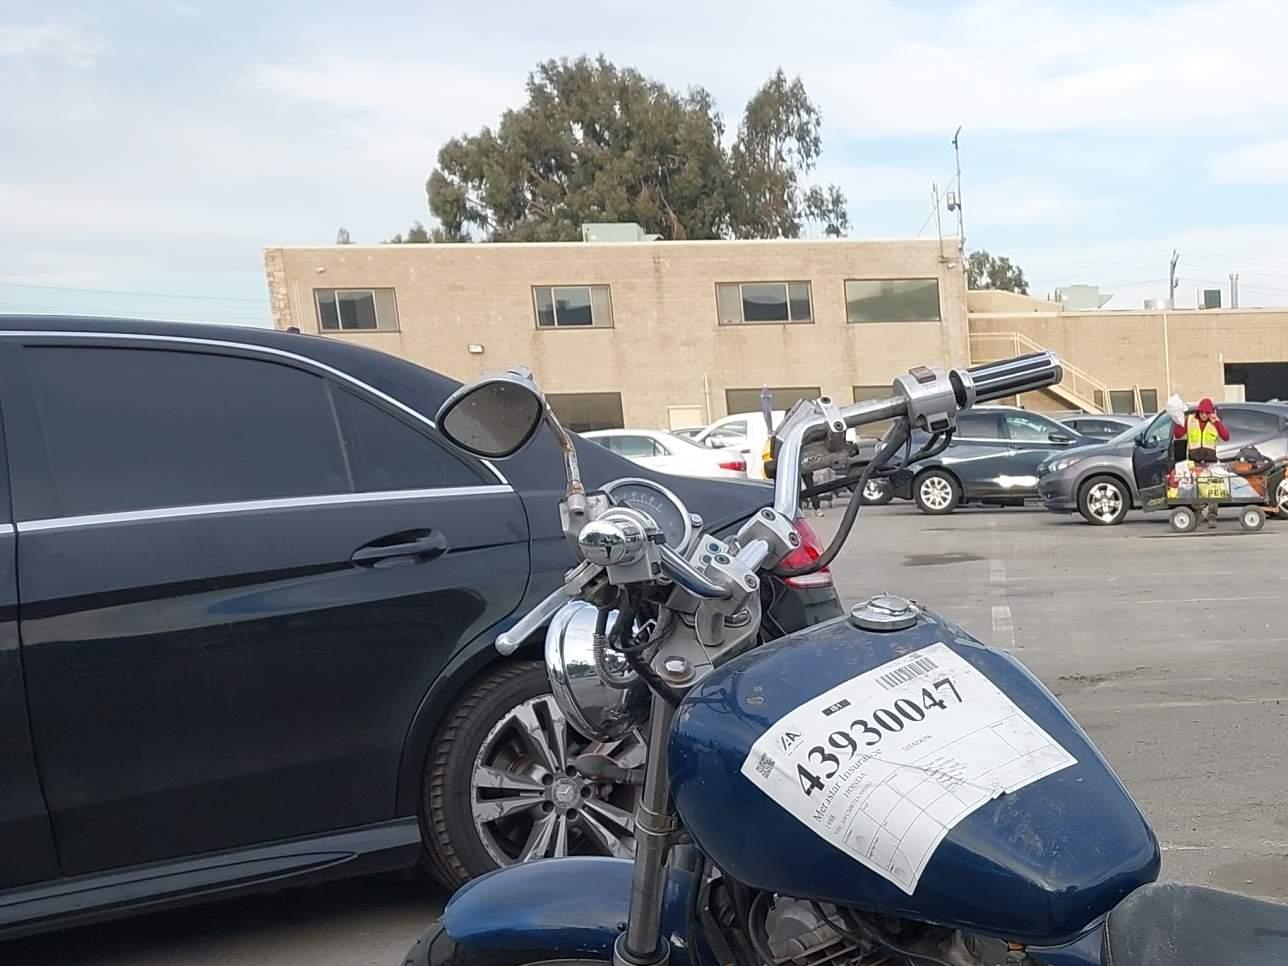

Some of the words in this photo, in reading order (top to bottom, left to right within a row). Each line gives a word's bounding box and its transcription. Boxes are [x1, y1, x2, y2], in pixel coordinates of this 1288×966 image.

[797, 678, 962, 796] 43930047
[813, 782, 841, 822] Merastar
[839, 749, 881, 781] Insurance
[843, 773, 867, 798] HONDA
